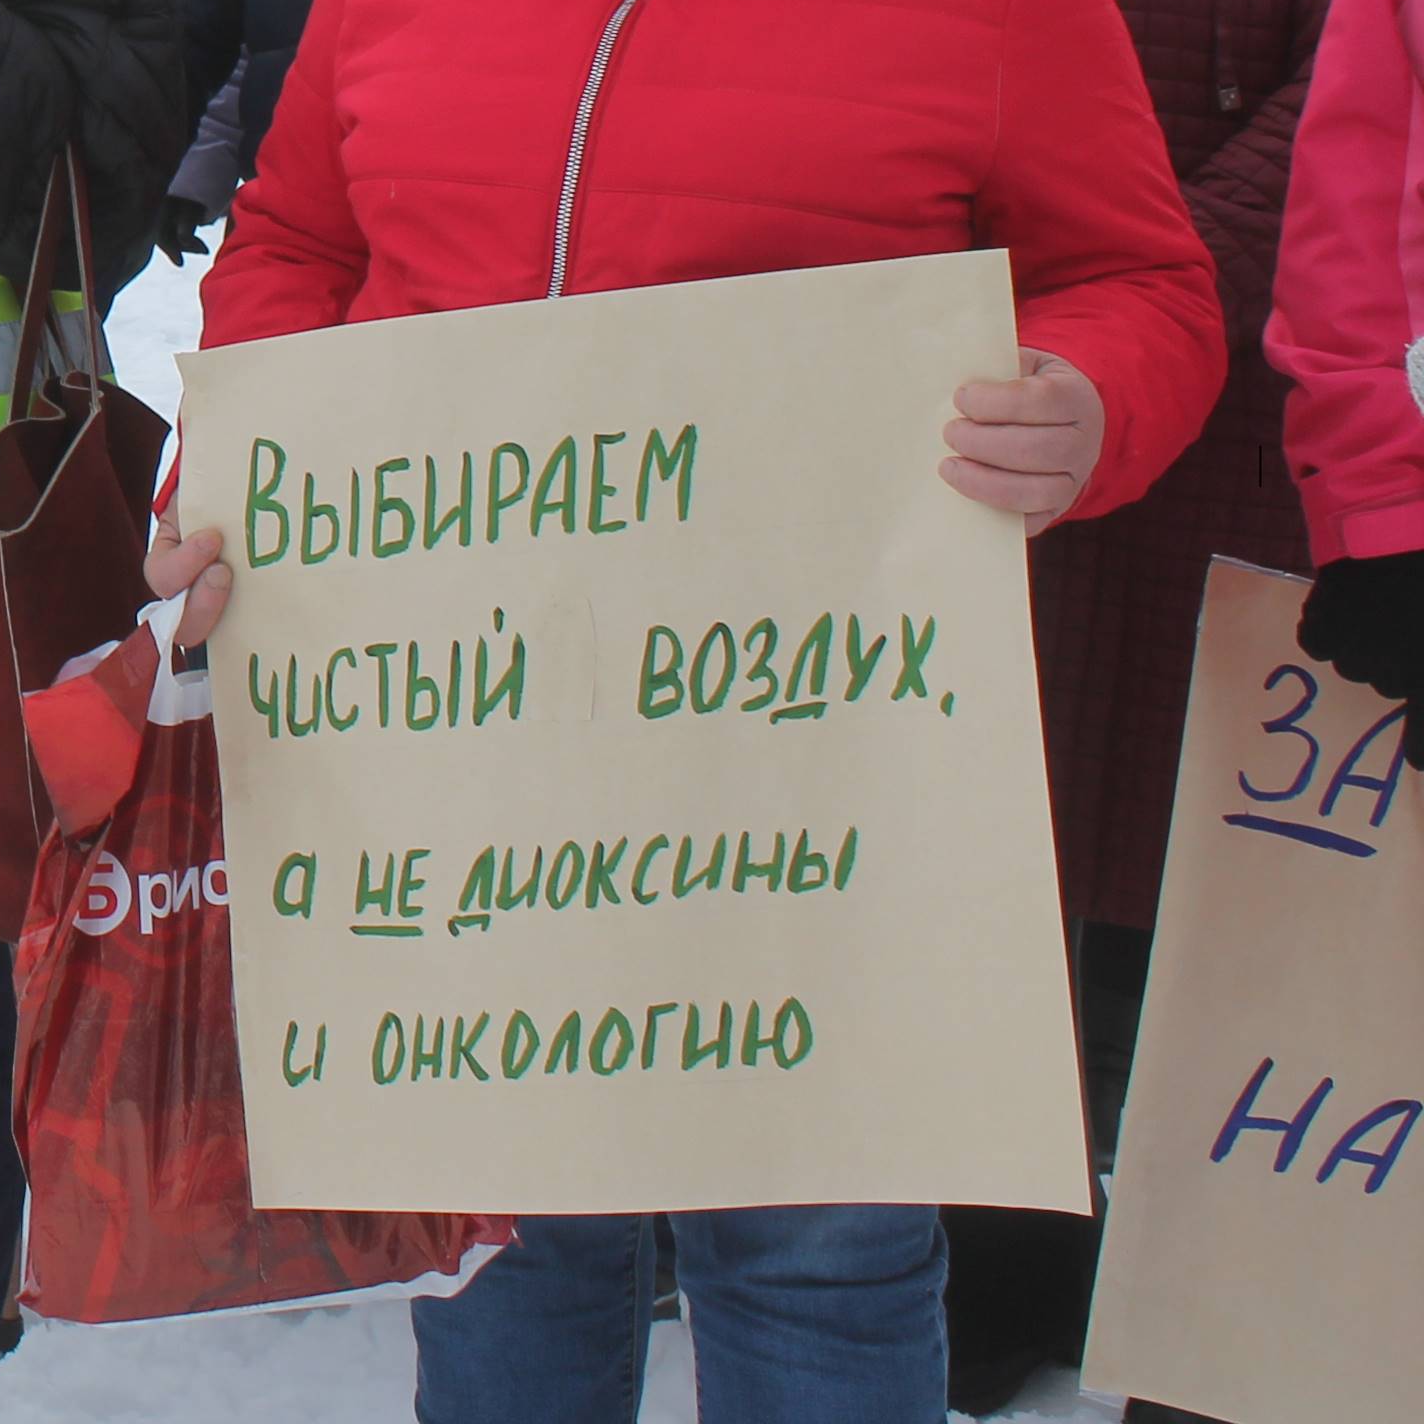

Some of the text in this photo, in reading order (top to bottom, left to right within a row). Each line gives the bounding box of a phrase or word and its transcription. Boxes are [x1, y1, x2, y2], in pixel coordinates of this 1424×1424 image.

[248, 606, 526, 740] ЧИСТЫЙ
[353, 847, 432, 921] НЕ
[447, 825, 859, 938] ДИОКСИНЫ
[370, 996, 815, 1086] ОНКОЛОГИЮ
